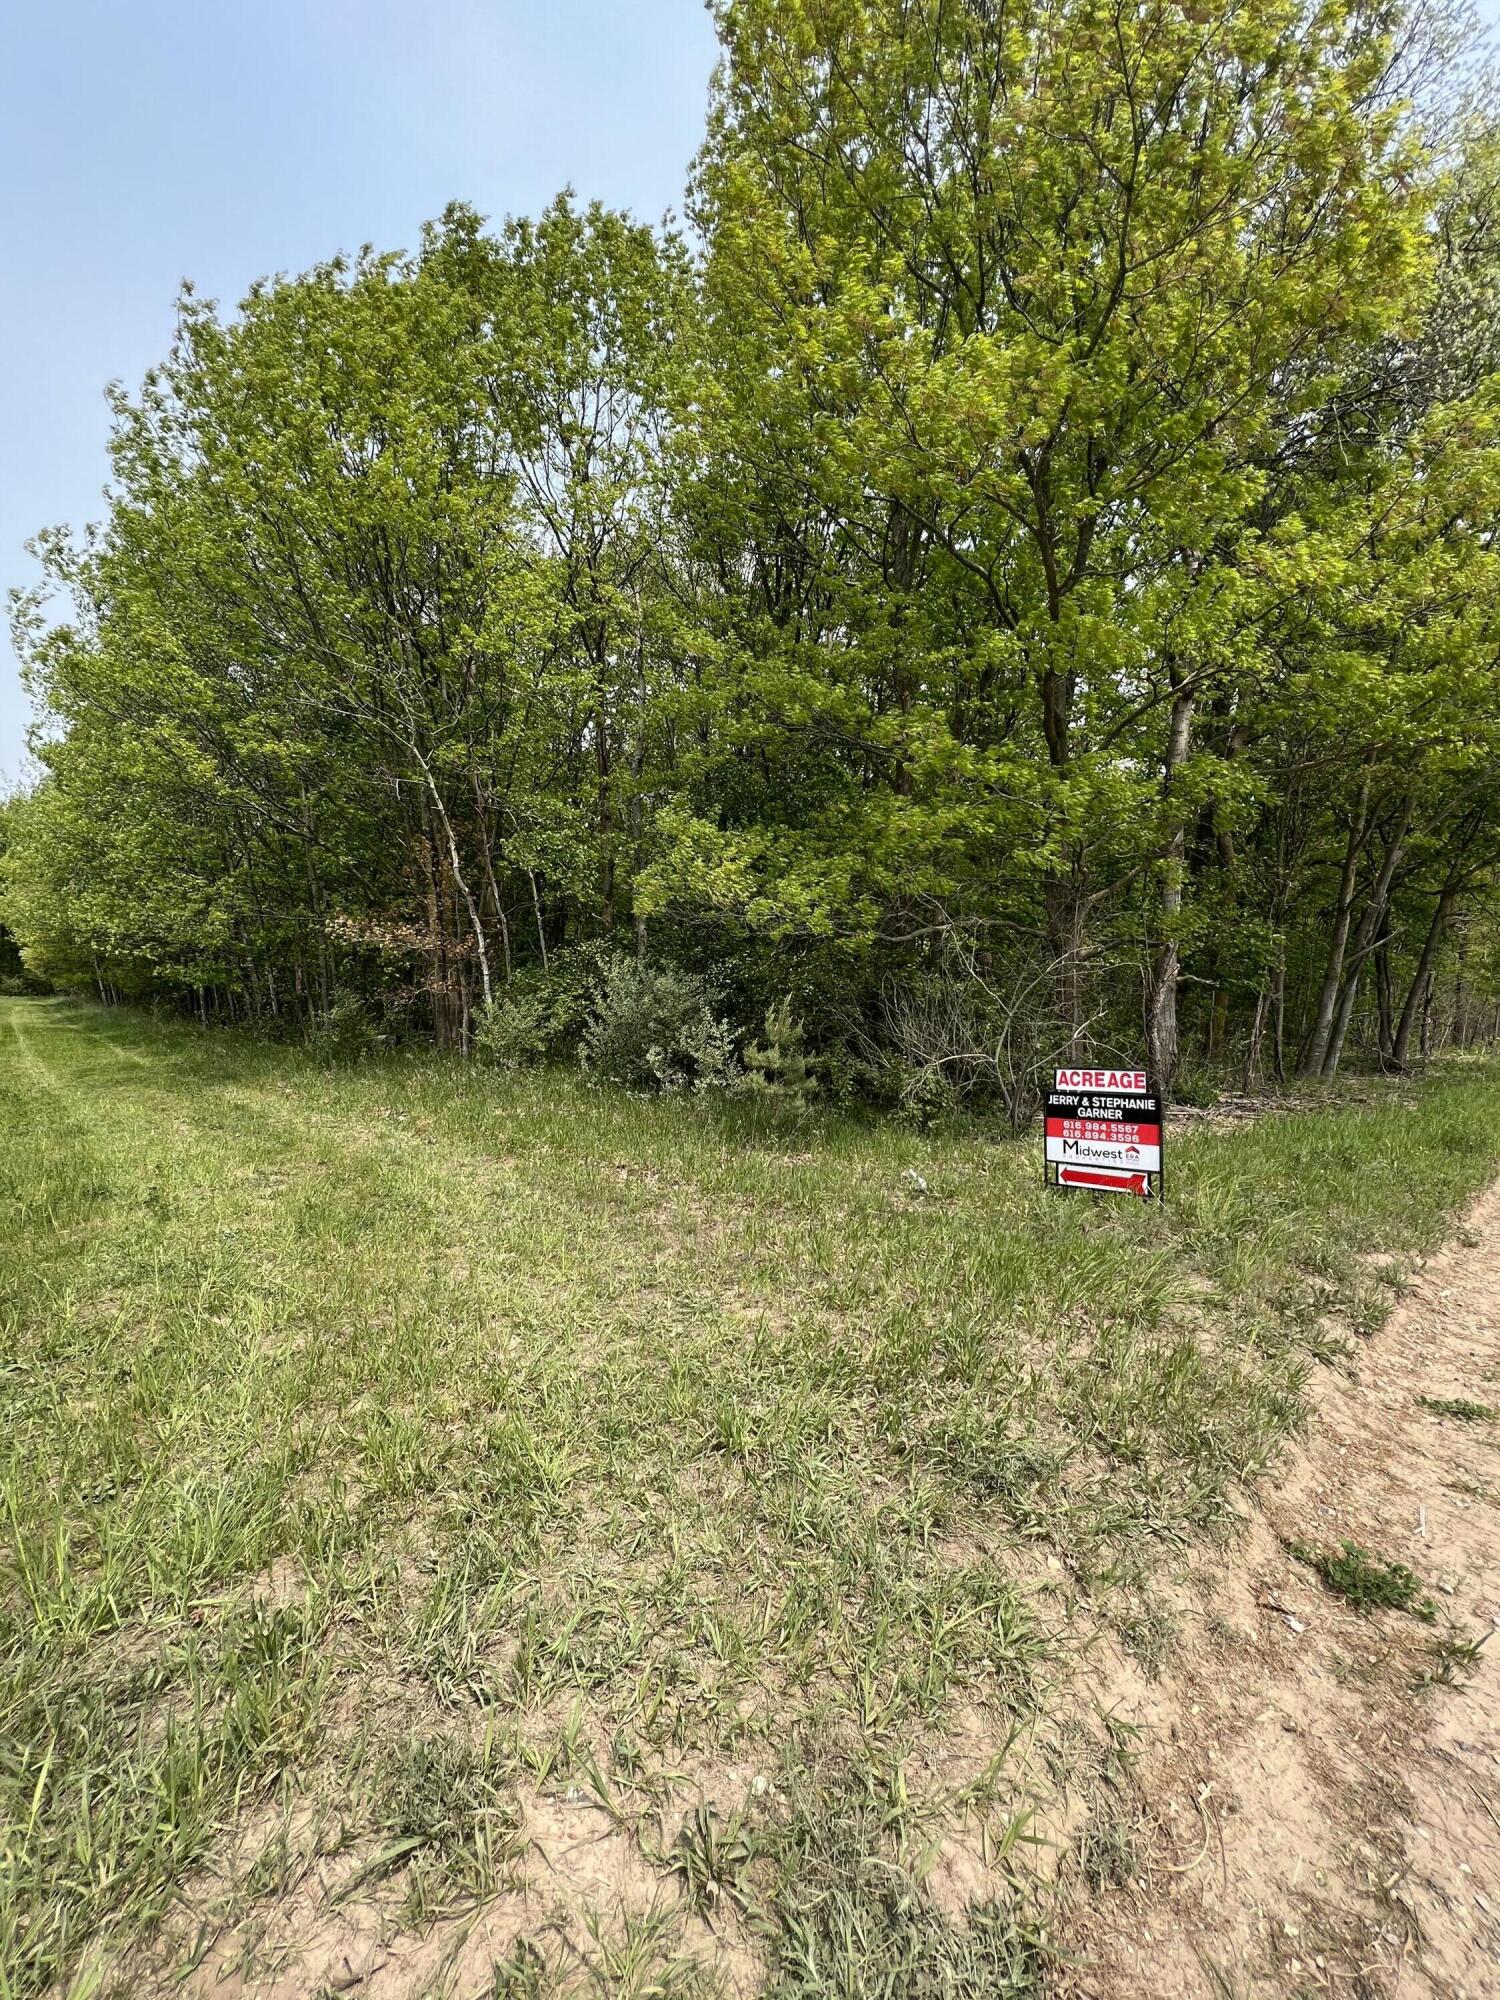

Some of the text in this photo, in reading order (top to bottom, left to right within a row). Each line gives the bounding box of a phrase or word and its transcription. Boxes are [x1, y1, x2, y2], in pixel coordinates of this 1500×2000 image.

[1058, 1071, 1146, 1089] ACREAGE
[1048, 1095, 1156, 1110] JERRY & STEPHANIE
[1077, 1108, 1123, 1119] GARNER
[1063, 1121, 1139, 1133] 616.984.5567
[1063, 1130, 1139, 1143] 616.894.3596
[1063, 1139, 1123, 1159] Midwest
